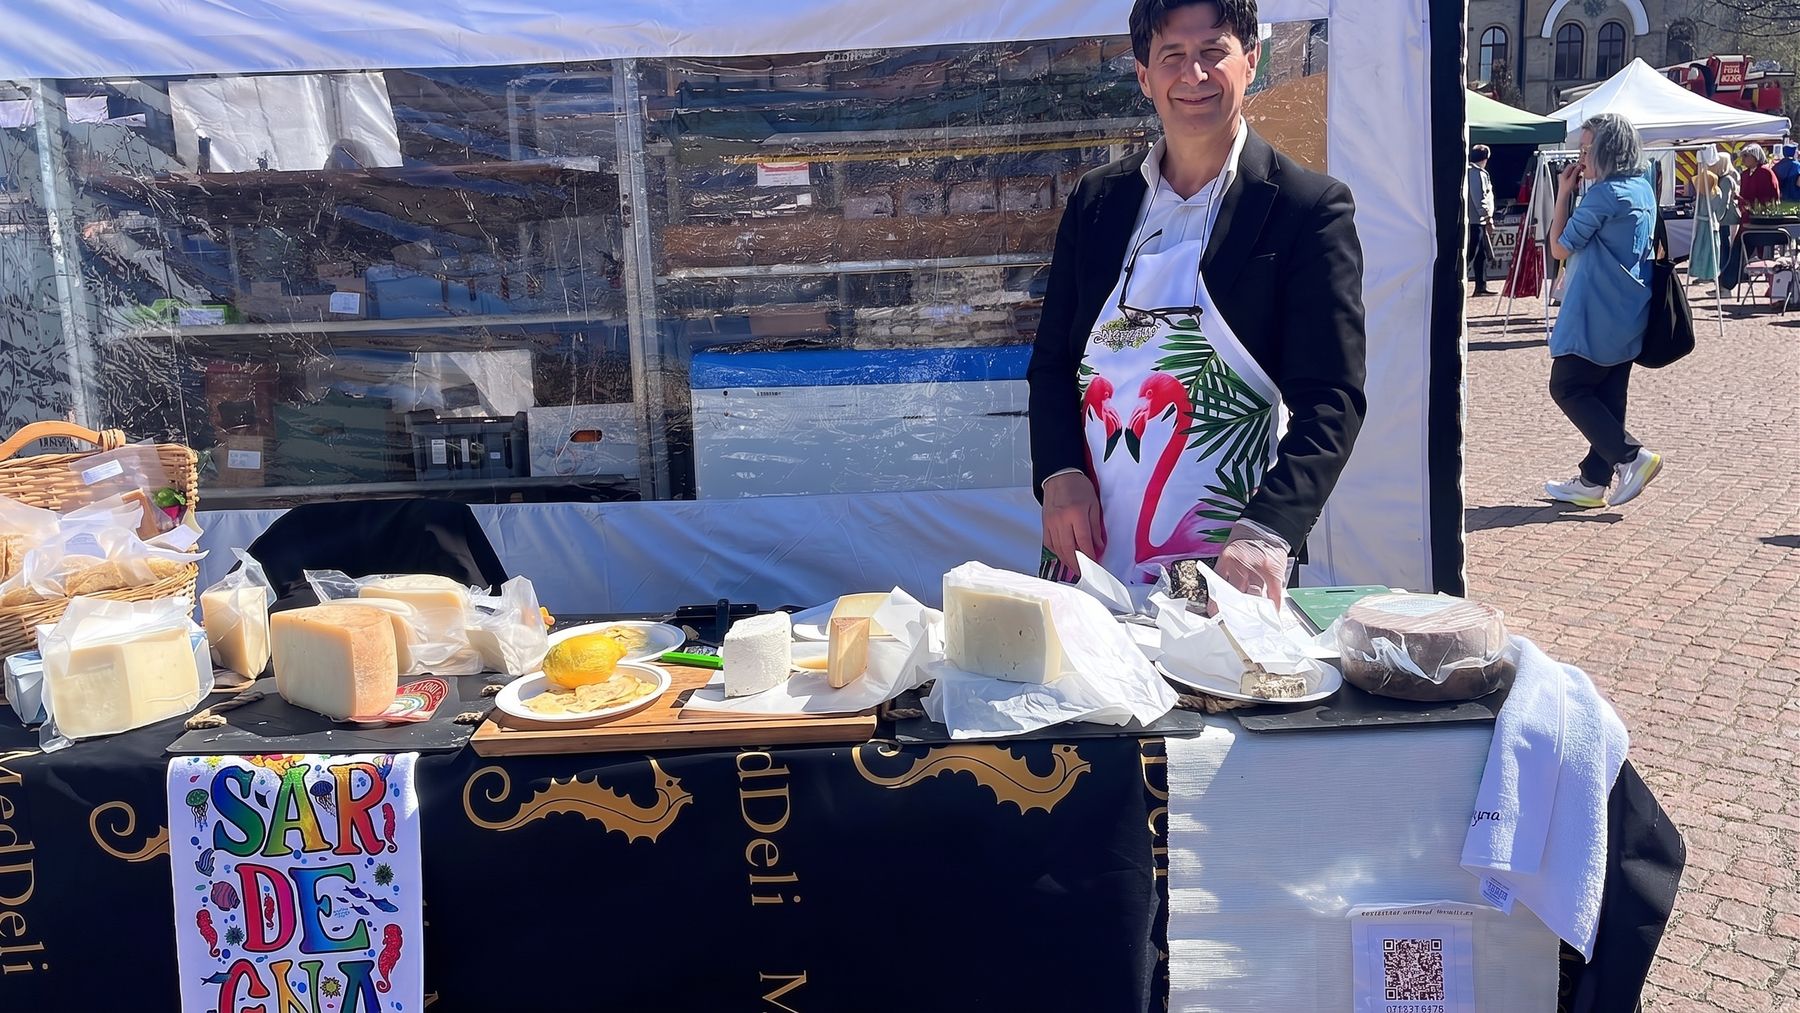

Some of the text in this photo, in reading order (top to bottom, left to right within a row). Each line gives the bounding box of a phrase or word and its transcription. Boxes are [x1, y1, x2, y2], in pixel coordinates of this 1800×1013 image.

[210, 762, 387, 857] SAR
[736, 747, 801, 907] dDeli
[234, 862, 371, 954] DE
